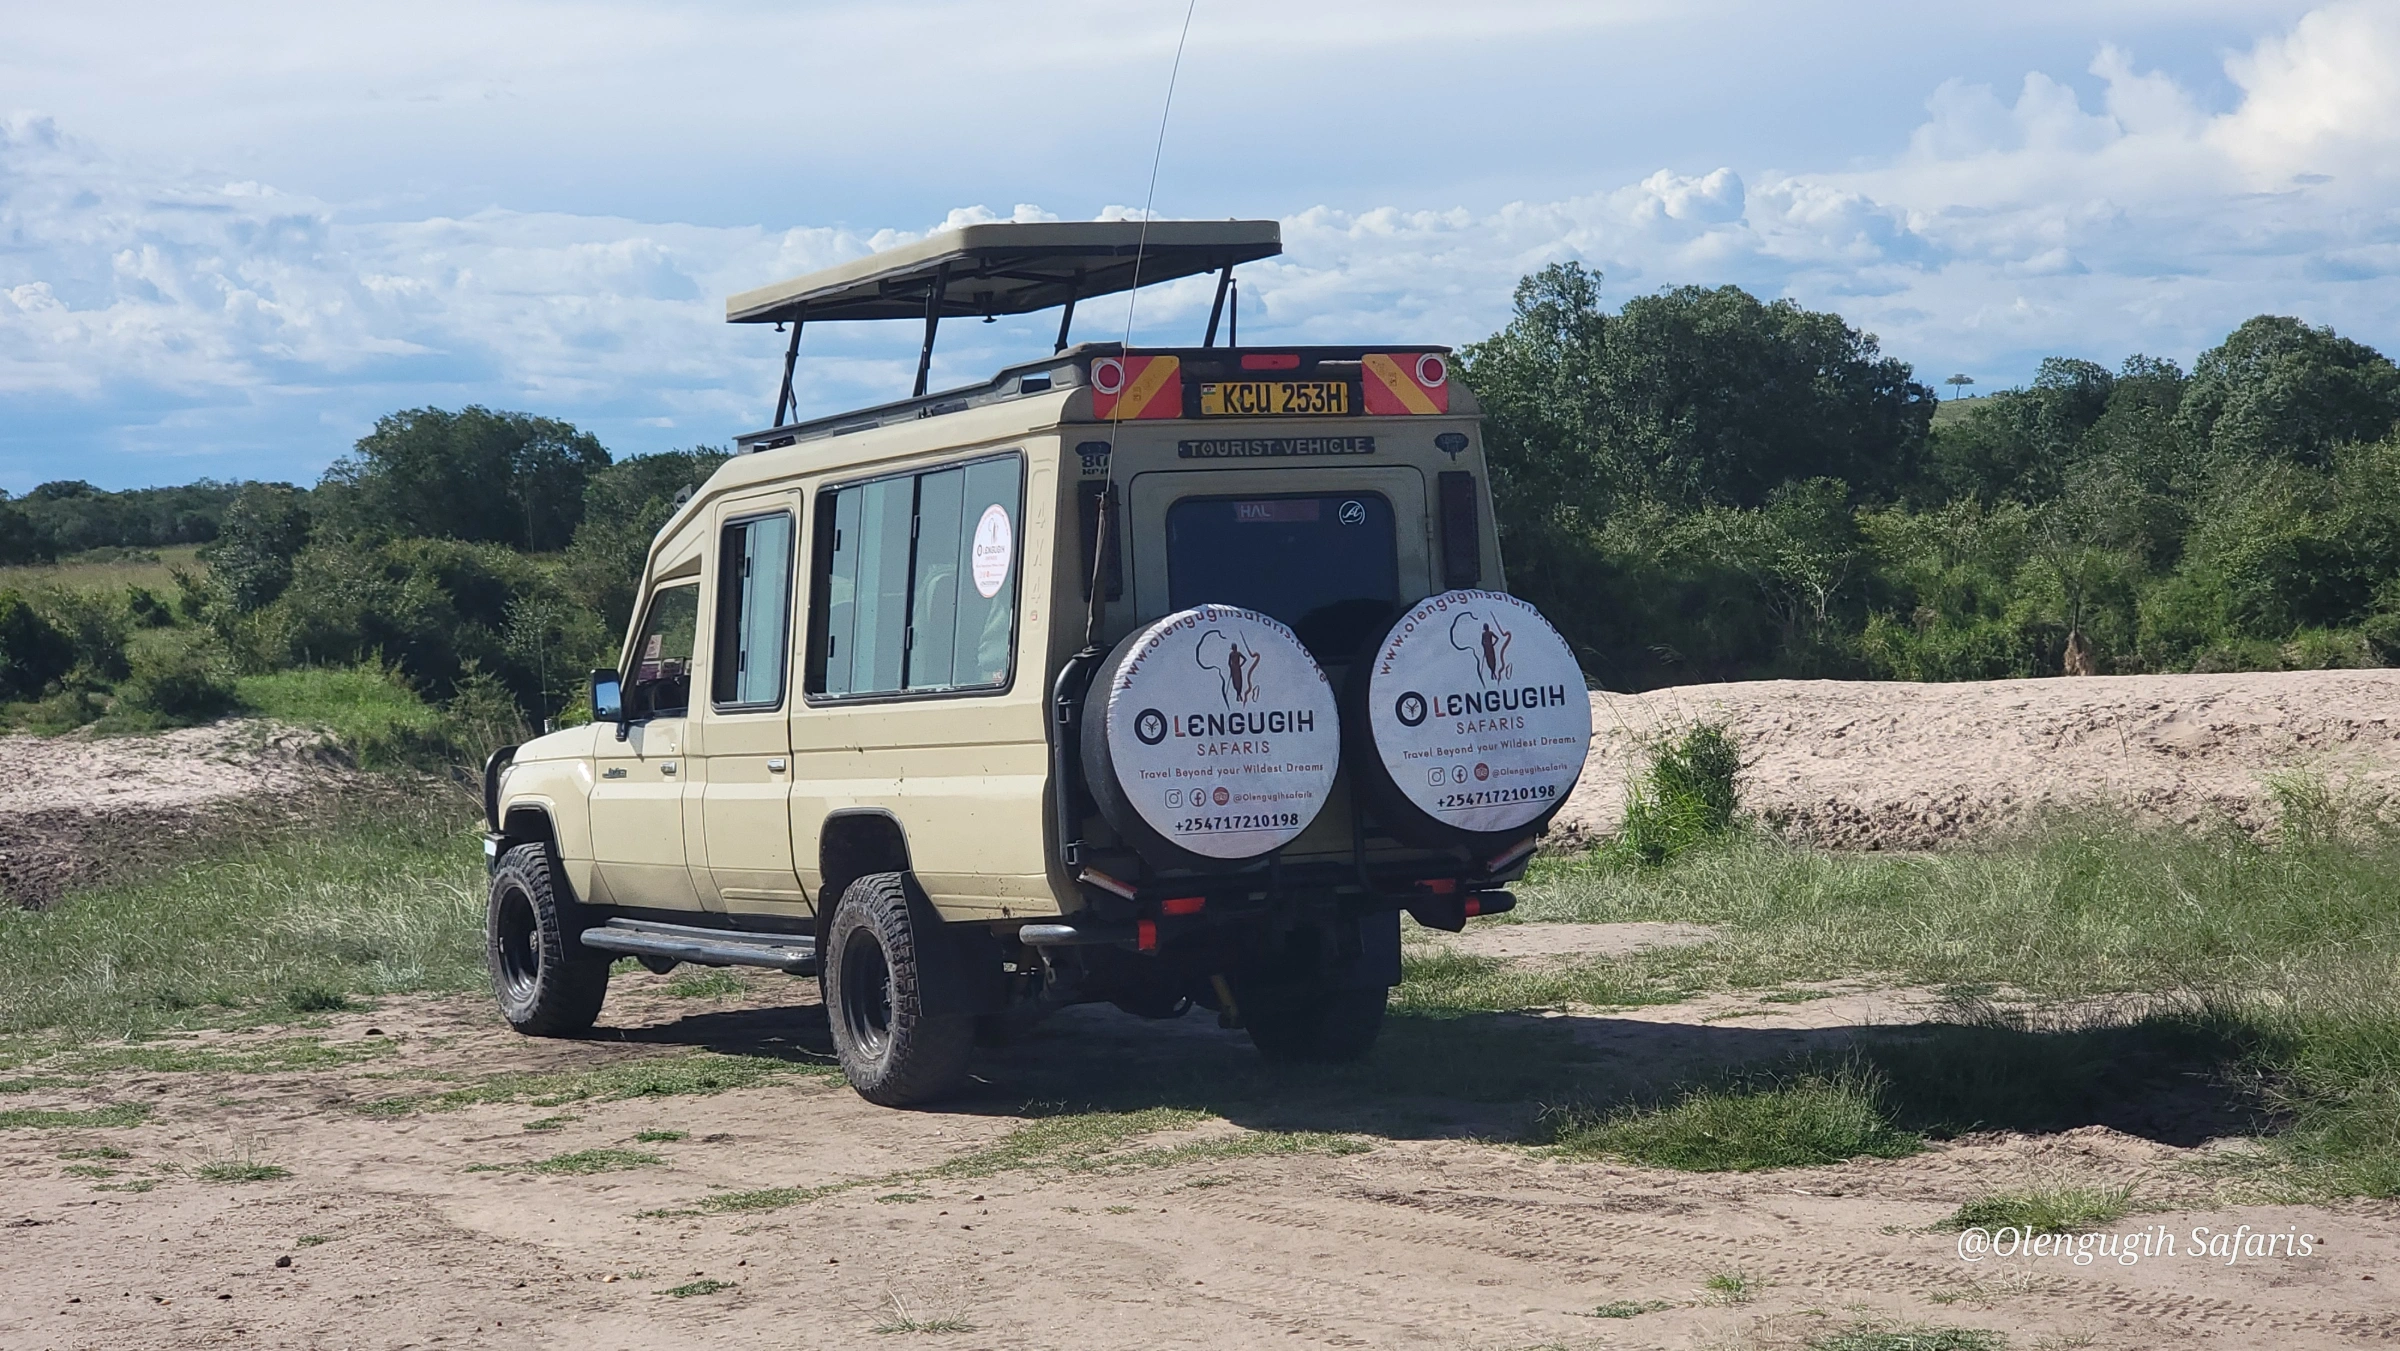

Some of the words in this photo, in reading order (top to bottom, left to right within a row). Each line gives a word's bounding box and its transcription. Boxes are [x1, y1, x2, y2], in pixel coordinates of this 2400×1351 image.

[1222, 384, 1271, 413] KCU
[1282, 383, 1342, 412] 253H
[1187, 440, 1276, 457] TOURIST
[1282, 438, 1366, 454] VEHICLE
[1395, 684, 1566, 727] OLENGUGIH
[1134, 708, 1314, 746] OLENGUGIH
[1456, 716, 1525, 735] SAFARIS
[1197, 740, 1271, 757] SAFARIS
[1403, 747, 1433, 760] Travel
[1437, 744, 1474, 757] Beyond
[1476, 742, 1499, 754] your
[1500, 739, 1537, 750] Wildest
[1541, 736, 1577, 746] Dreams
[1140, 768, 1172, 780] Travel
[1175, 765, 1214, 780] Beyond
[1217, 767, 1241, 778] your
[1243, 763, 1283, 774] Wildest
[1286, 763, 1324, 773] Dreams
[1437, 785, 1556, 808] +254717210198
[1175, 813, 1299, 832] +254717210198
